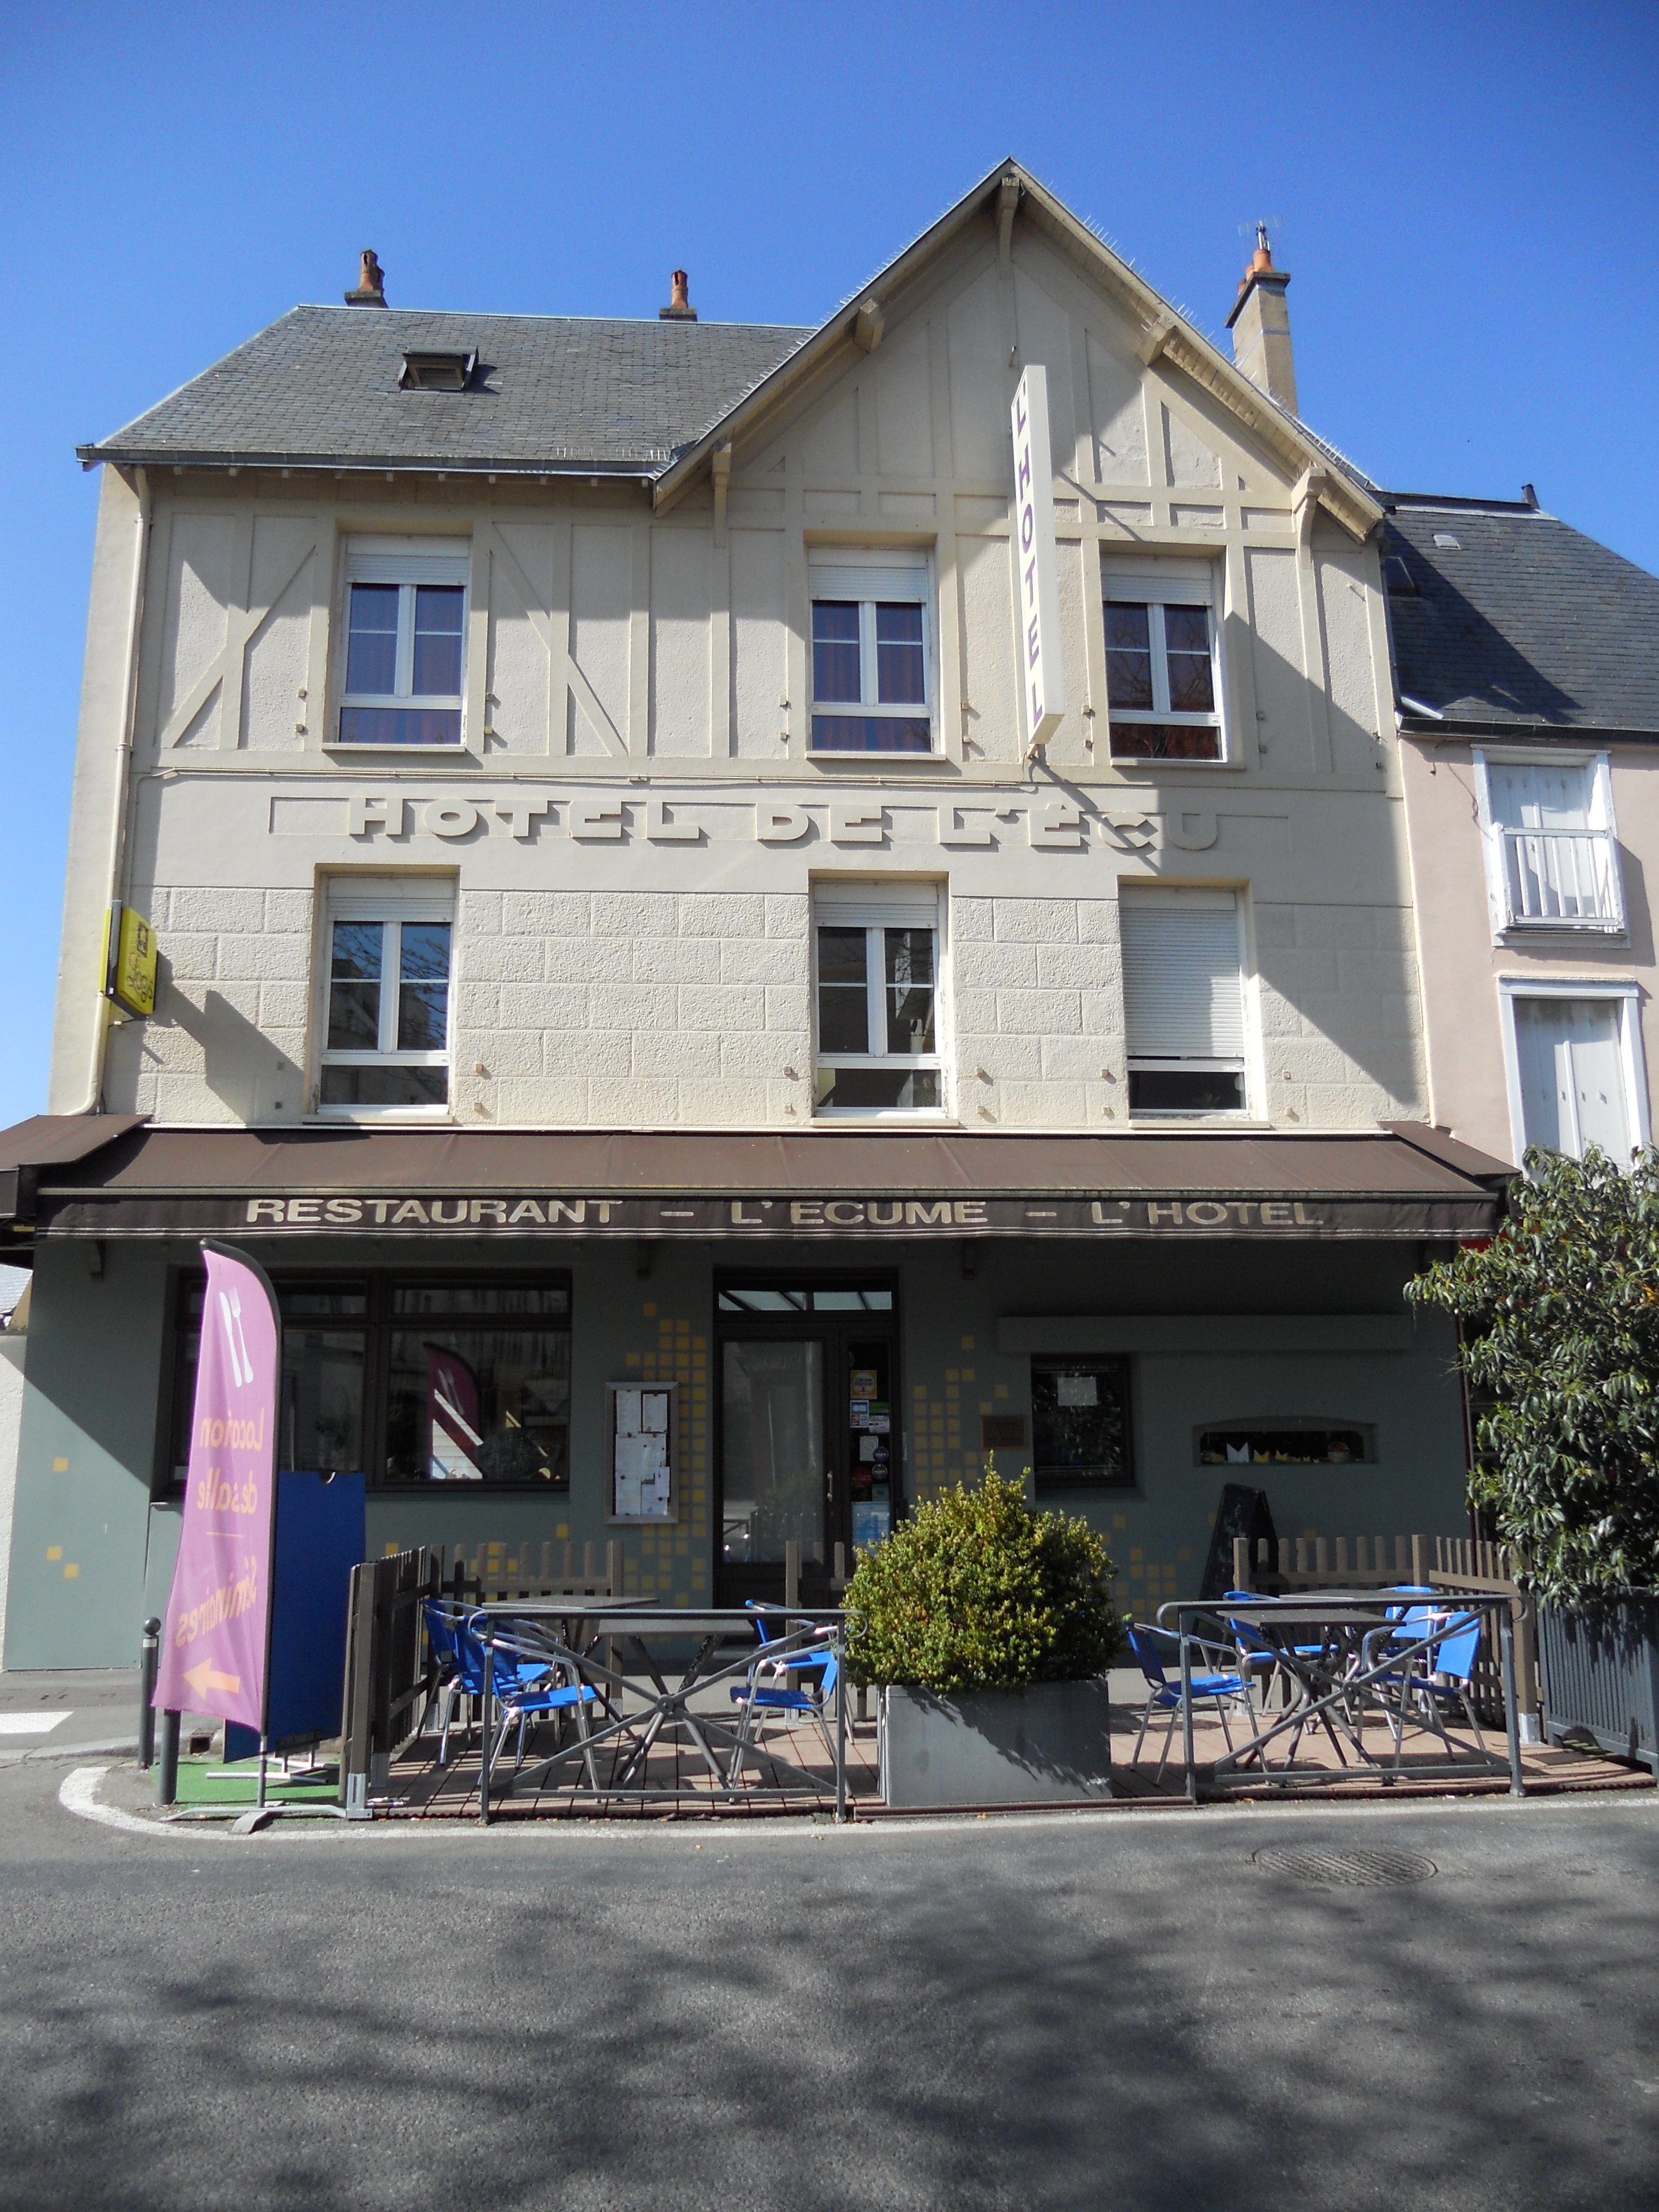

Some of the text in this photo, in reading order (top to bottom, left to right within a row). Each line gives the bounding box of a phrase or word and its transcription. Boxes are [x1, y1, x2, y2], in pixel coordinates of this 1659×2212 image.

[1016, 380, 1044, 729] L'HOTEL
[348, 797, 700, 840] HOTEL
[755, 804, 883, 842] DE
[246, 1198, 623, 1223] RESTAURANT
